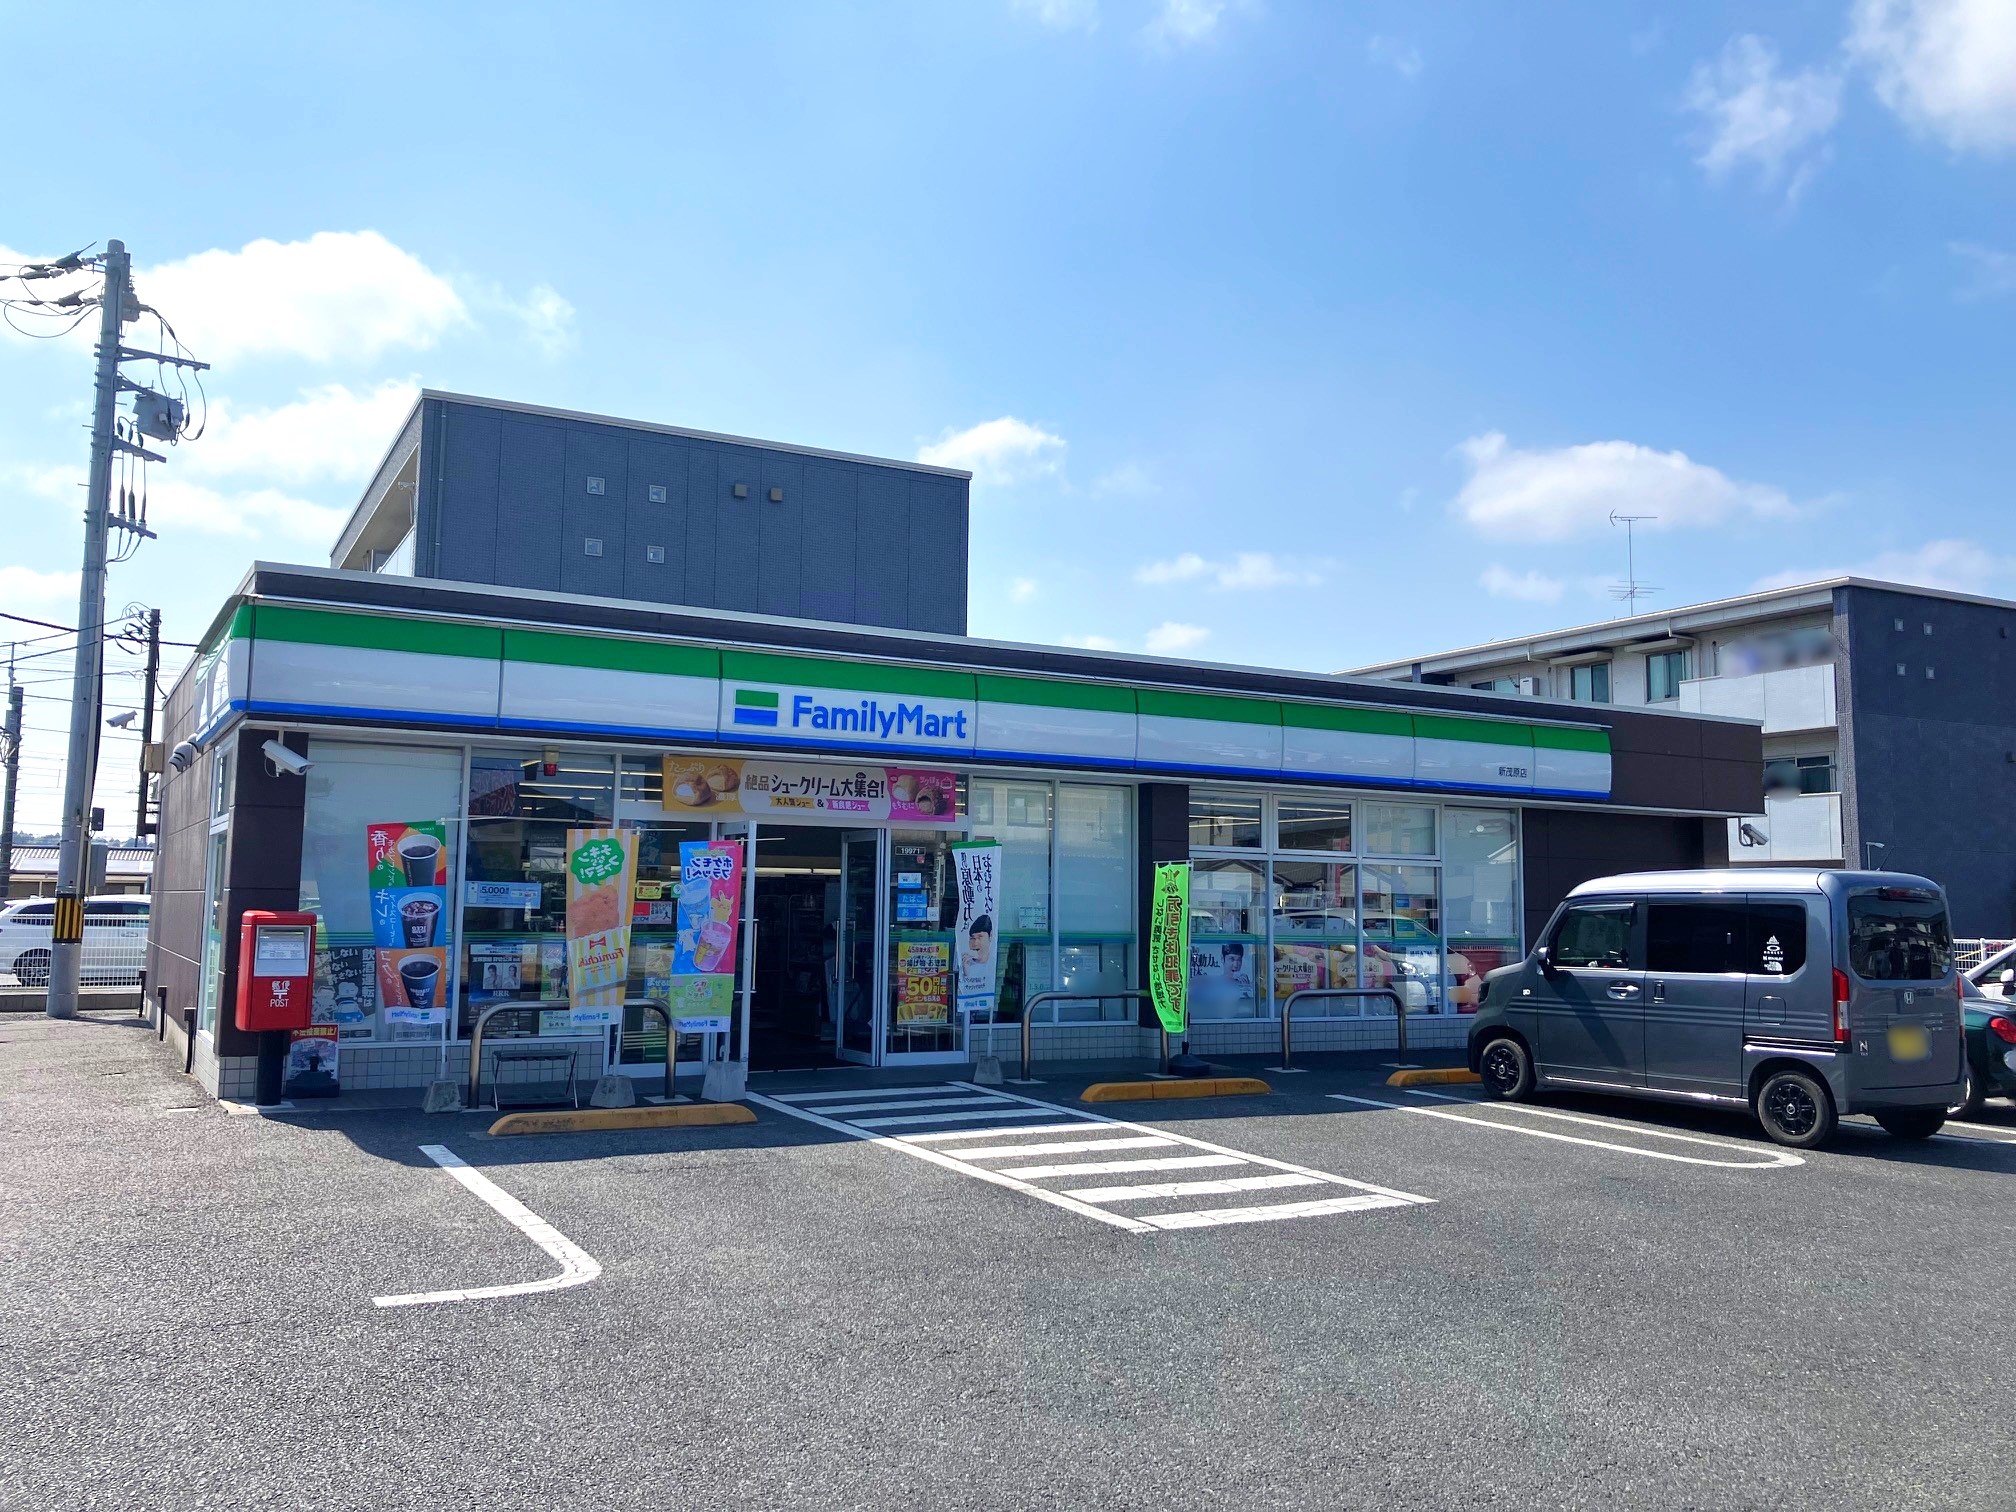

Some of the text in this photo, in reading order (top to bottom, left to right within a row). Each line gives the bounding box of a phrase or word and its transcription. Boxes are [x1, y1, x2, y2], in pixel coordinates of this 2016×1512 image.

[792, 695, 967, 739] FamilyMart
[1498, 766, 1528, 778] 新茂原店
[775, 797, 811, 808] 大人気シュー
[816, 798, 824, 808] &
[902, 895, 923, 903] たばこ
[361, 948, 376, 1007] 飲酒運転は
[270, 999, 289, 1007] POST
[1859, 1040, 1868, 1051] N
